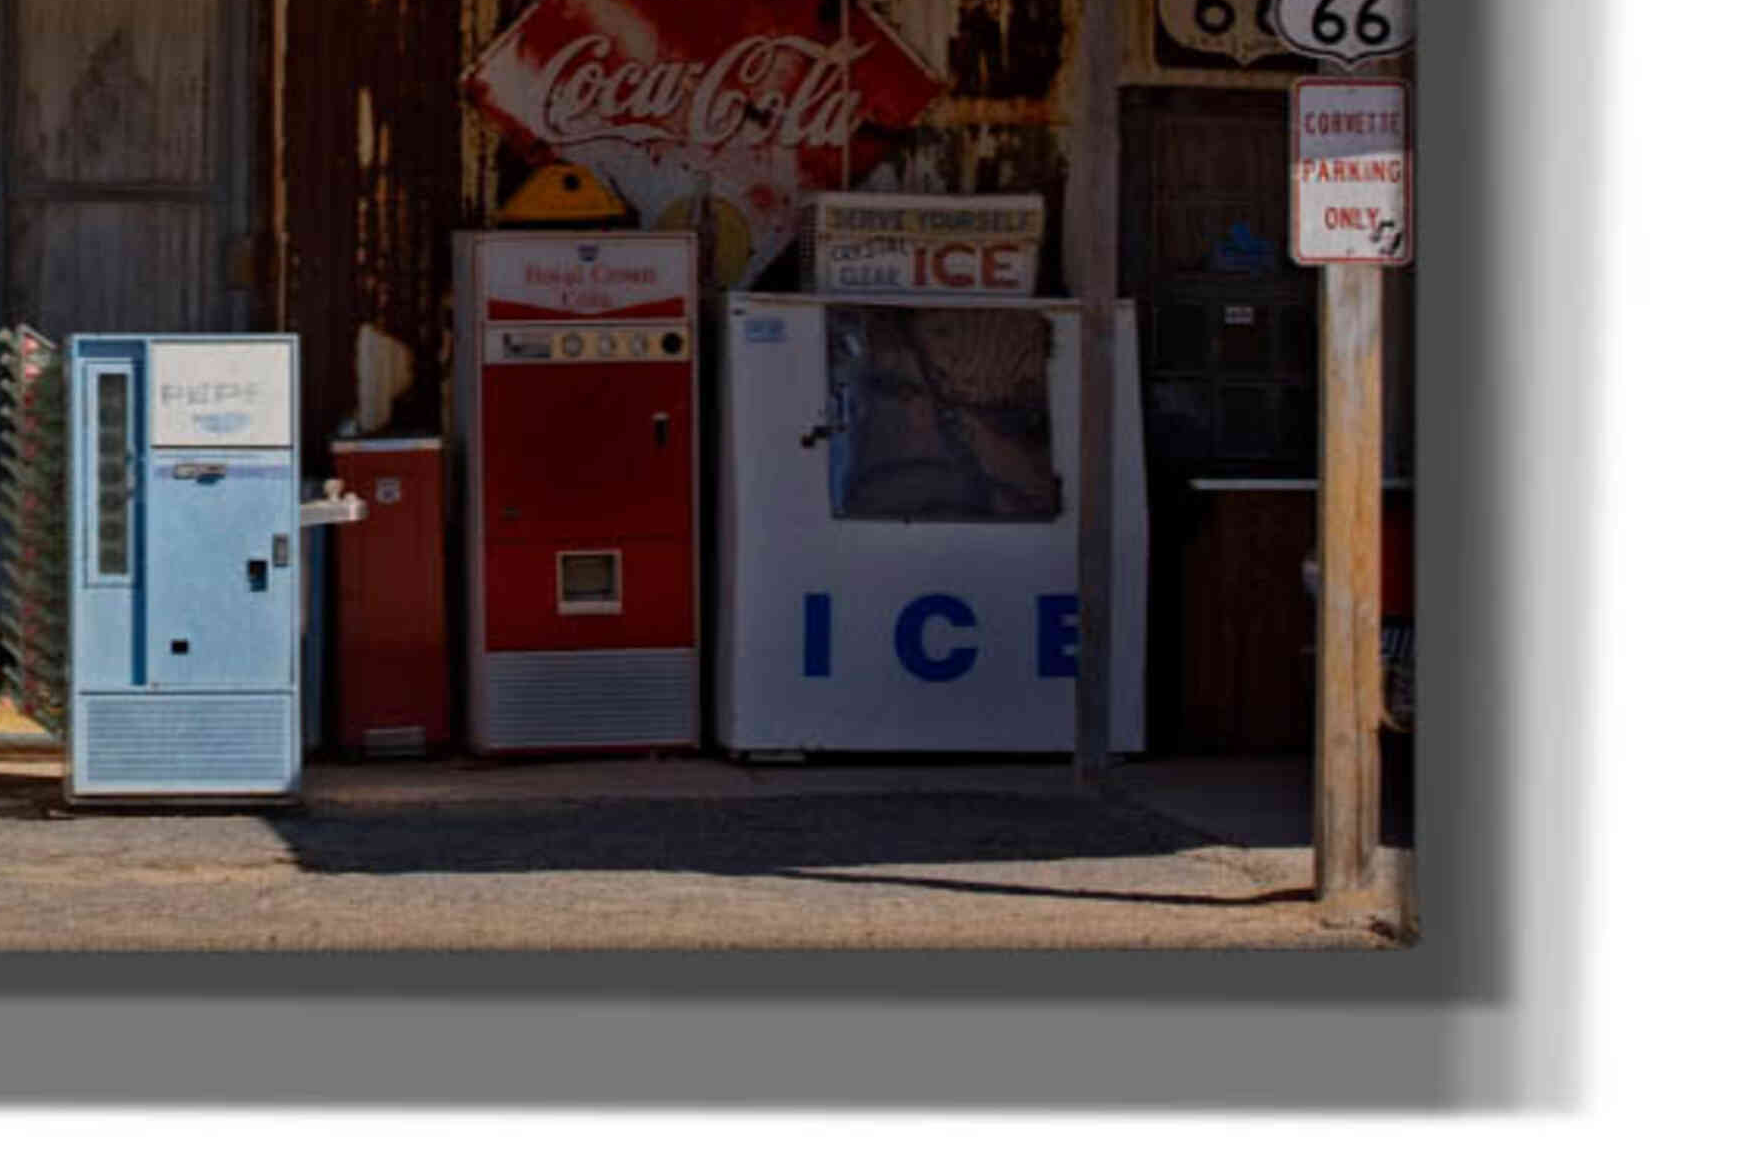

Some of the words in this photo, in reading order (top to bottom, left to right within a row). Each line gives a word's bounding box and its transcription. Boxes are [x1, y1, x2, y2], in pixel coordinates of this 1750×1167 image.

[544, 34, 876, 148] Coca-Cola
[1304, 110, 1402, 134] CORVETTE
[1302, 156, 1402, 183] PARKING
[1325, 206, 1380, 230] ONLY
[913, 244, 1020, 287] ICE
